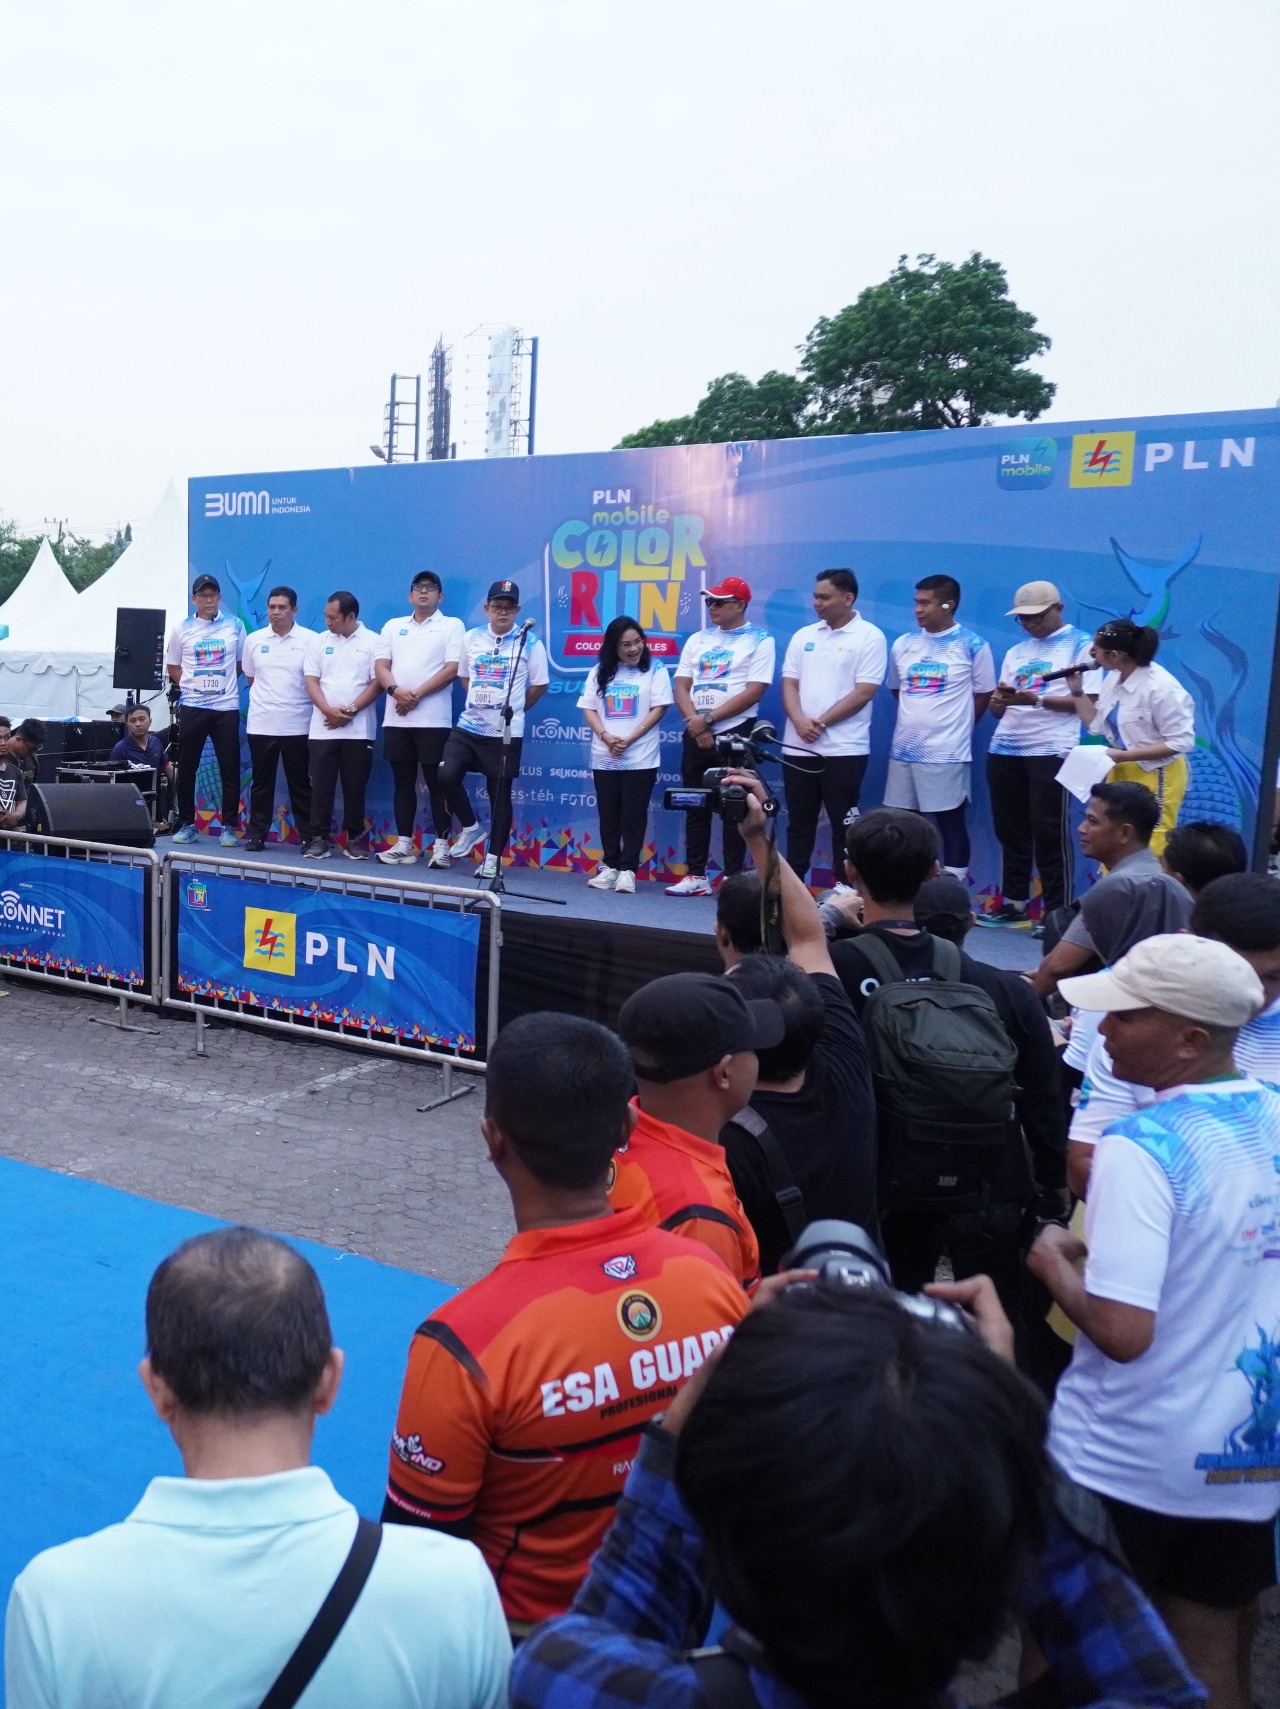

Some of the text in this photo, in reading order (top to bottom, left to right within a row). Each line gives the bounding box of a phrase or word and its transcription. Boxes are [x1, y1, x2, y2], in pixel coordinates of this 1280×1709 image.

[1001, 453, 1030, 465] PLN
[1143, 436, 1257, 472] PLN
[1000, 464, 1052, 477] mobile
[204, 490, 270, 517] BUMN
[271, 496, 297, 505] UNTUK
[592, 488, 631, 505] PLN
[271, 505, 311, 514] INDONESIA
[592, 505, 670, 527] mobile
[551, 514, 708, 581] COLOR
[570, 569, 681, 633] RUN
[575, 642, 604, 651] COLO
[202, 679, 219, 688] 1730
[697, 694, 715, 706] 1765
[531, 718, 592, 741] ICONNE
[520, 765, 543, 776] LUS
[305, 931, 396, 980] PLN
[540, 1361, 620, 1418] ESA
